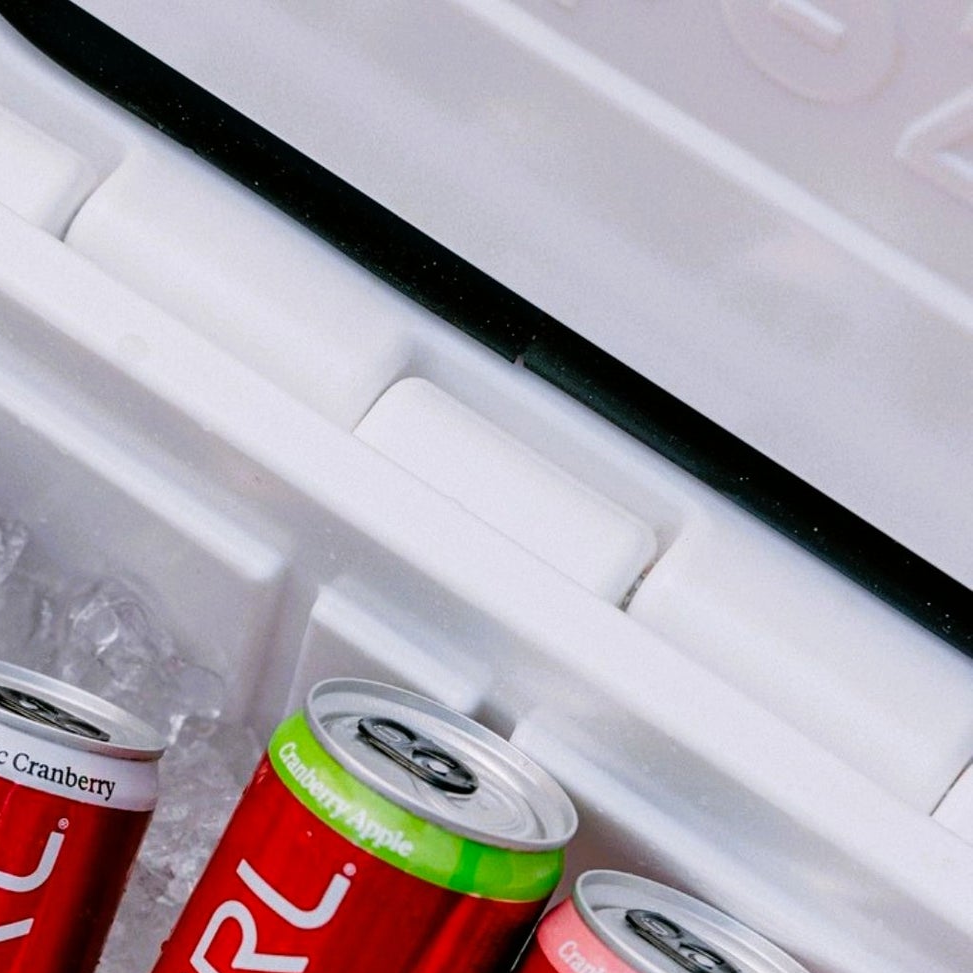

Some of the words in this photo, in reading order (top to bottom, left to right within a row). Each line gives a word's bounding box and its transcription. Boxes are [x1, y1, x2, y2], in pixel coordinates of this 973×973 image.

[12, 751, 116, 801] Cranberry
[278, 741, 348, 819] Cranberry
[346, 809, 415, 857] Apple
